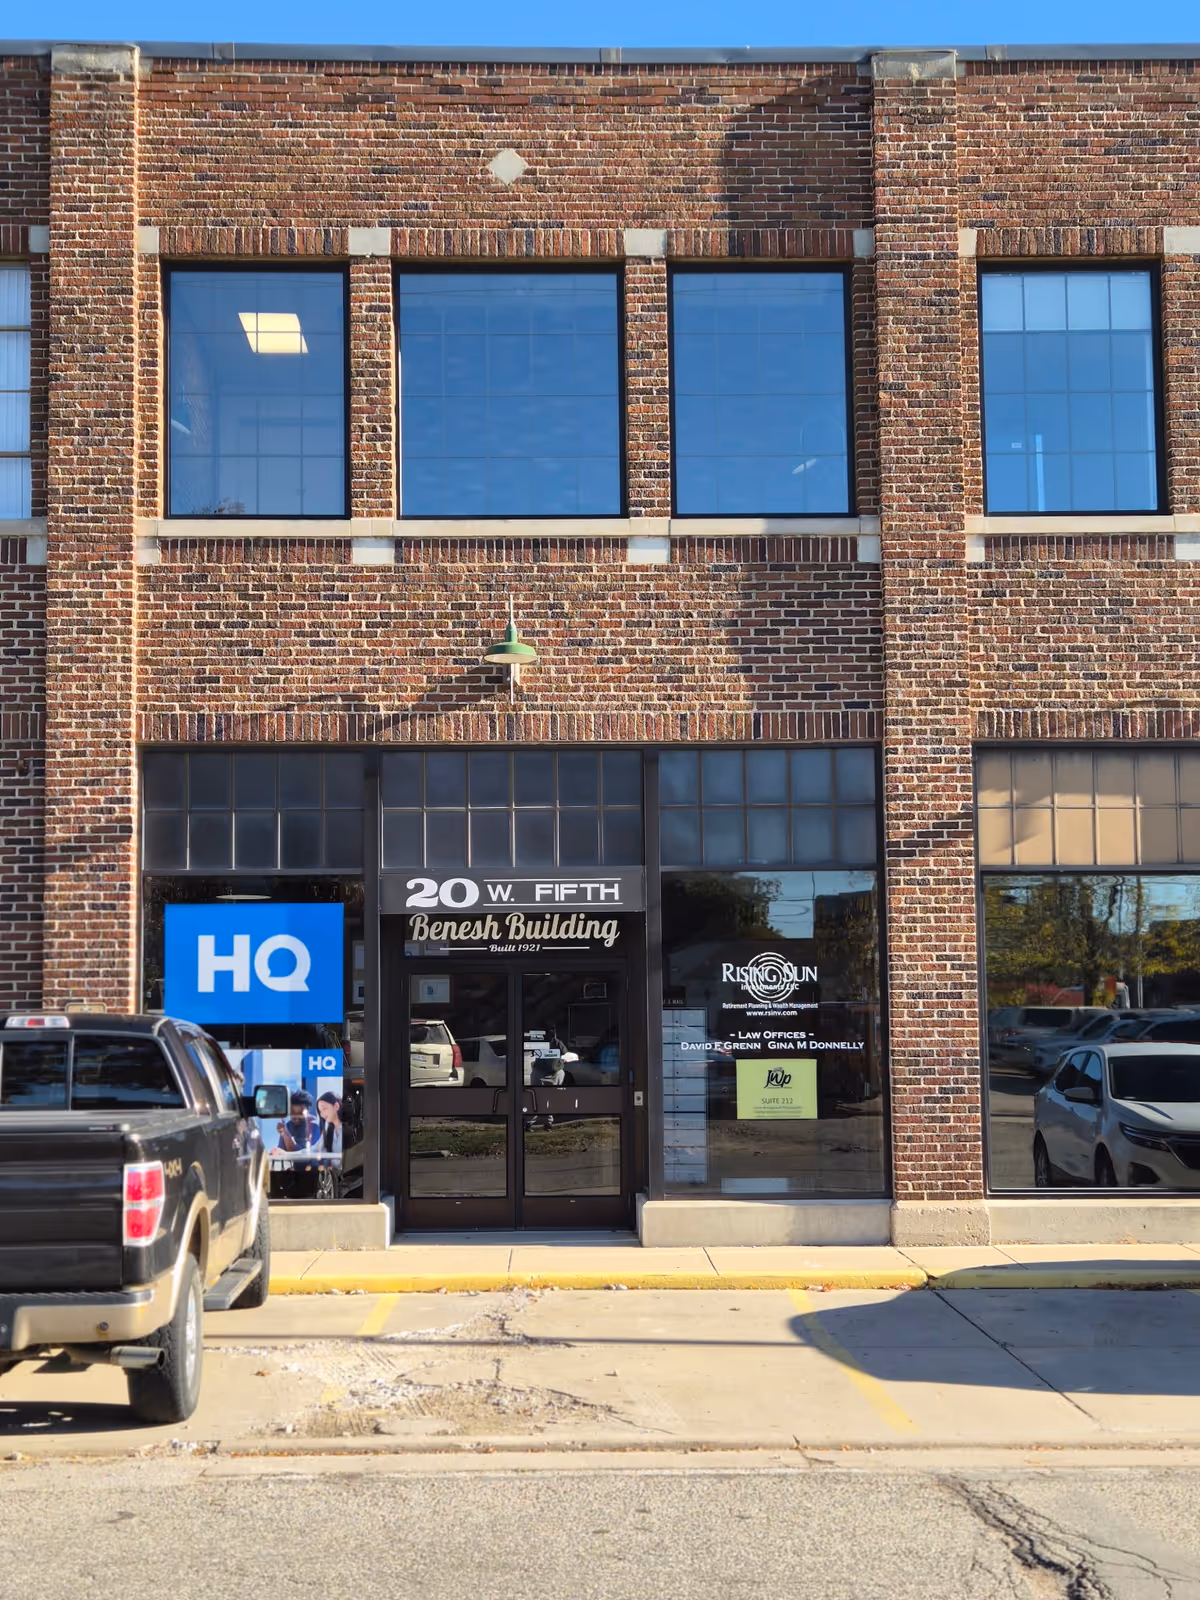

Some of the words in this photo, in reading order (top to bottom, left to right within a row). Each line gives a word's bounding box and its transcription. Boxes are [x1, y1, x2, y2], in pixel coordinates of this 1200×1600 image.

[406, 878, 479, 908] 20
[487, 884, 515, 902] W.
[535, 883, 620, 902] FIFTH
[409, 912, 502, 941] Benesh
[505, 912, 620, 947] Building
[489, 944, 517, 952] Built
[517, 944, 541, 952] 1921
[197, 934, 312, 993] HQ
[738, 1031, 761, 1039] LAW
[763, 1030, 806, 1039] OFFICES
[680, 1042, 713, 1050] DAVID
[767, 1041, 795, 1050] GINA
[796, 1041, 807, 1050] M
[809, 1041, 865, 1050] DONNELLY
[308, 1056, 337, 1070] HQ
[761, 1097, 780, 1105] SUITE
[781, 1097, 794, 1105] 212
